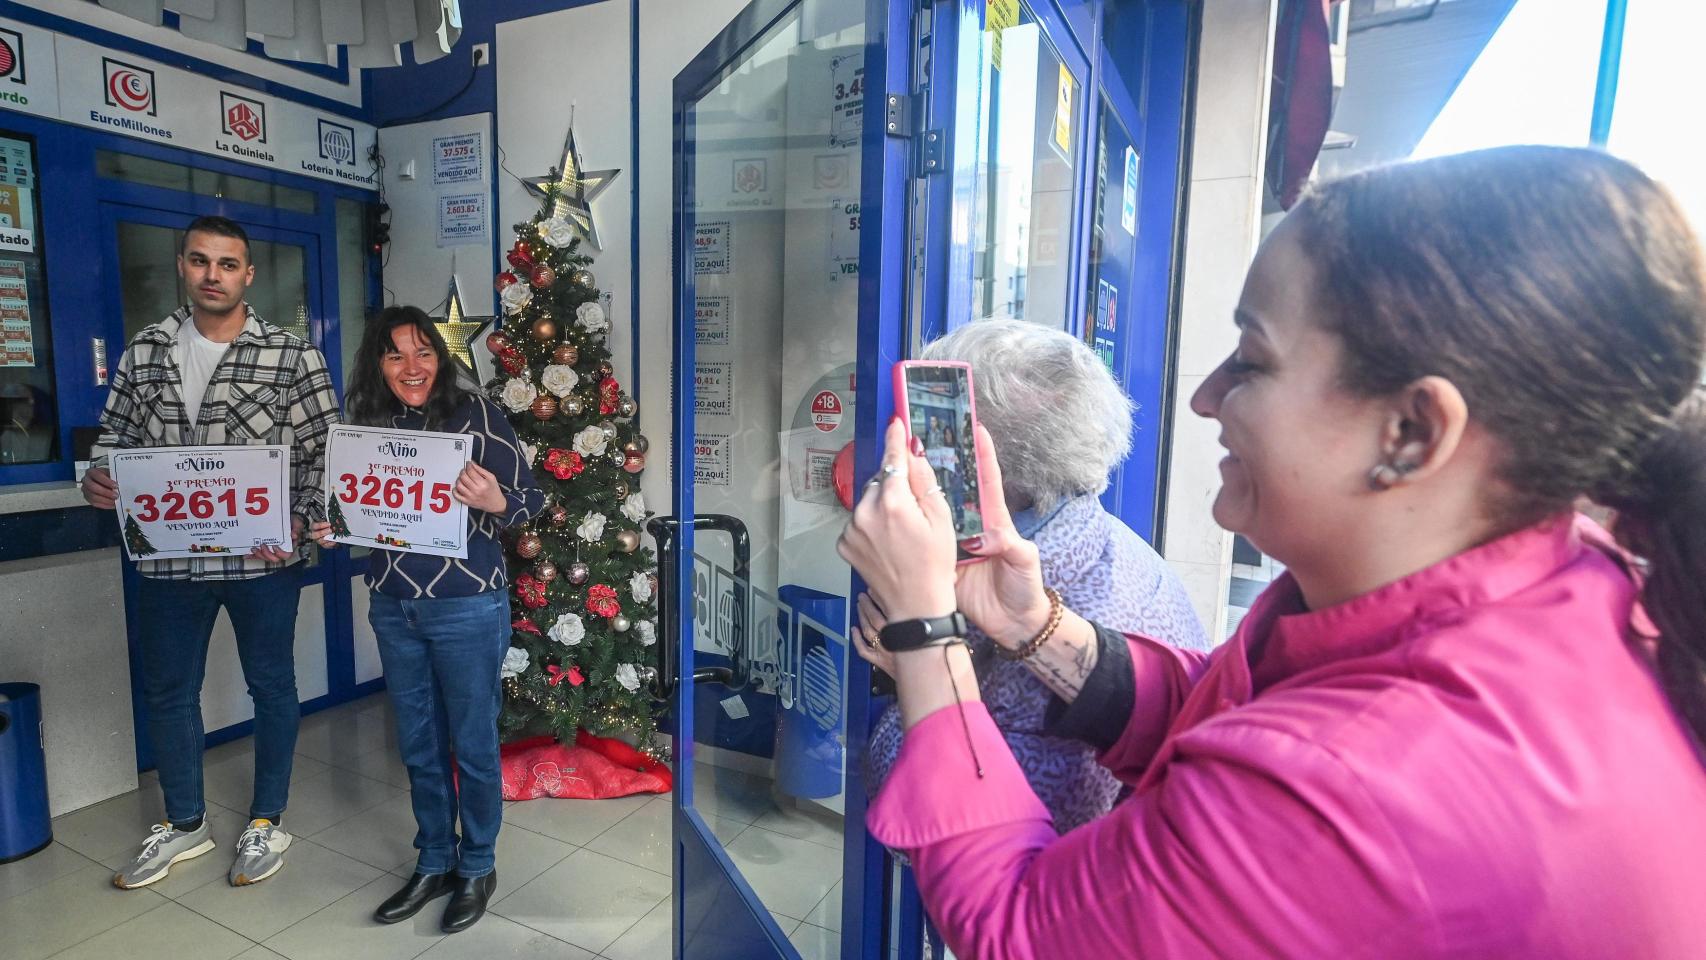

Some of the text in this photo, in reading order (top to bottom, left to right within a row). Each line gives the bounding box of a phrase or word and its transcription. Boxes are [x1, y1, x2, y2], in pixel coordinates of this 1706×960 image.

[90, 110, 173, 139] EuroMillones
[216, 140, 274, 162] La Quiniela
[444, 146, 468, 158] 37.575
[336, 168, 373, 184] Nacional
[464, 166, 478, 175] AQUÍ
[707, 260, 724, 268] AQUÍ
[707, 331, 724, 339] AQUÍ
[707, 400, 725, 409] AQUÍ
[817, 395, 835, 409] +18
[384, 442, 417, 457] Niño
[184, 458, 224, 471] Niño
[382, 464, 424, 477] PREMIO
[706, 470, 724, 479] AQUÍ
[165, 478, 236, 492] 3er PREMIO
[339, 473, 451, 514] 32615
[134, 487, 270, 522] 32615
[361, 509, 398, 519] VENDIDO
[165, 522, 212, 531] VENDIDO
